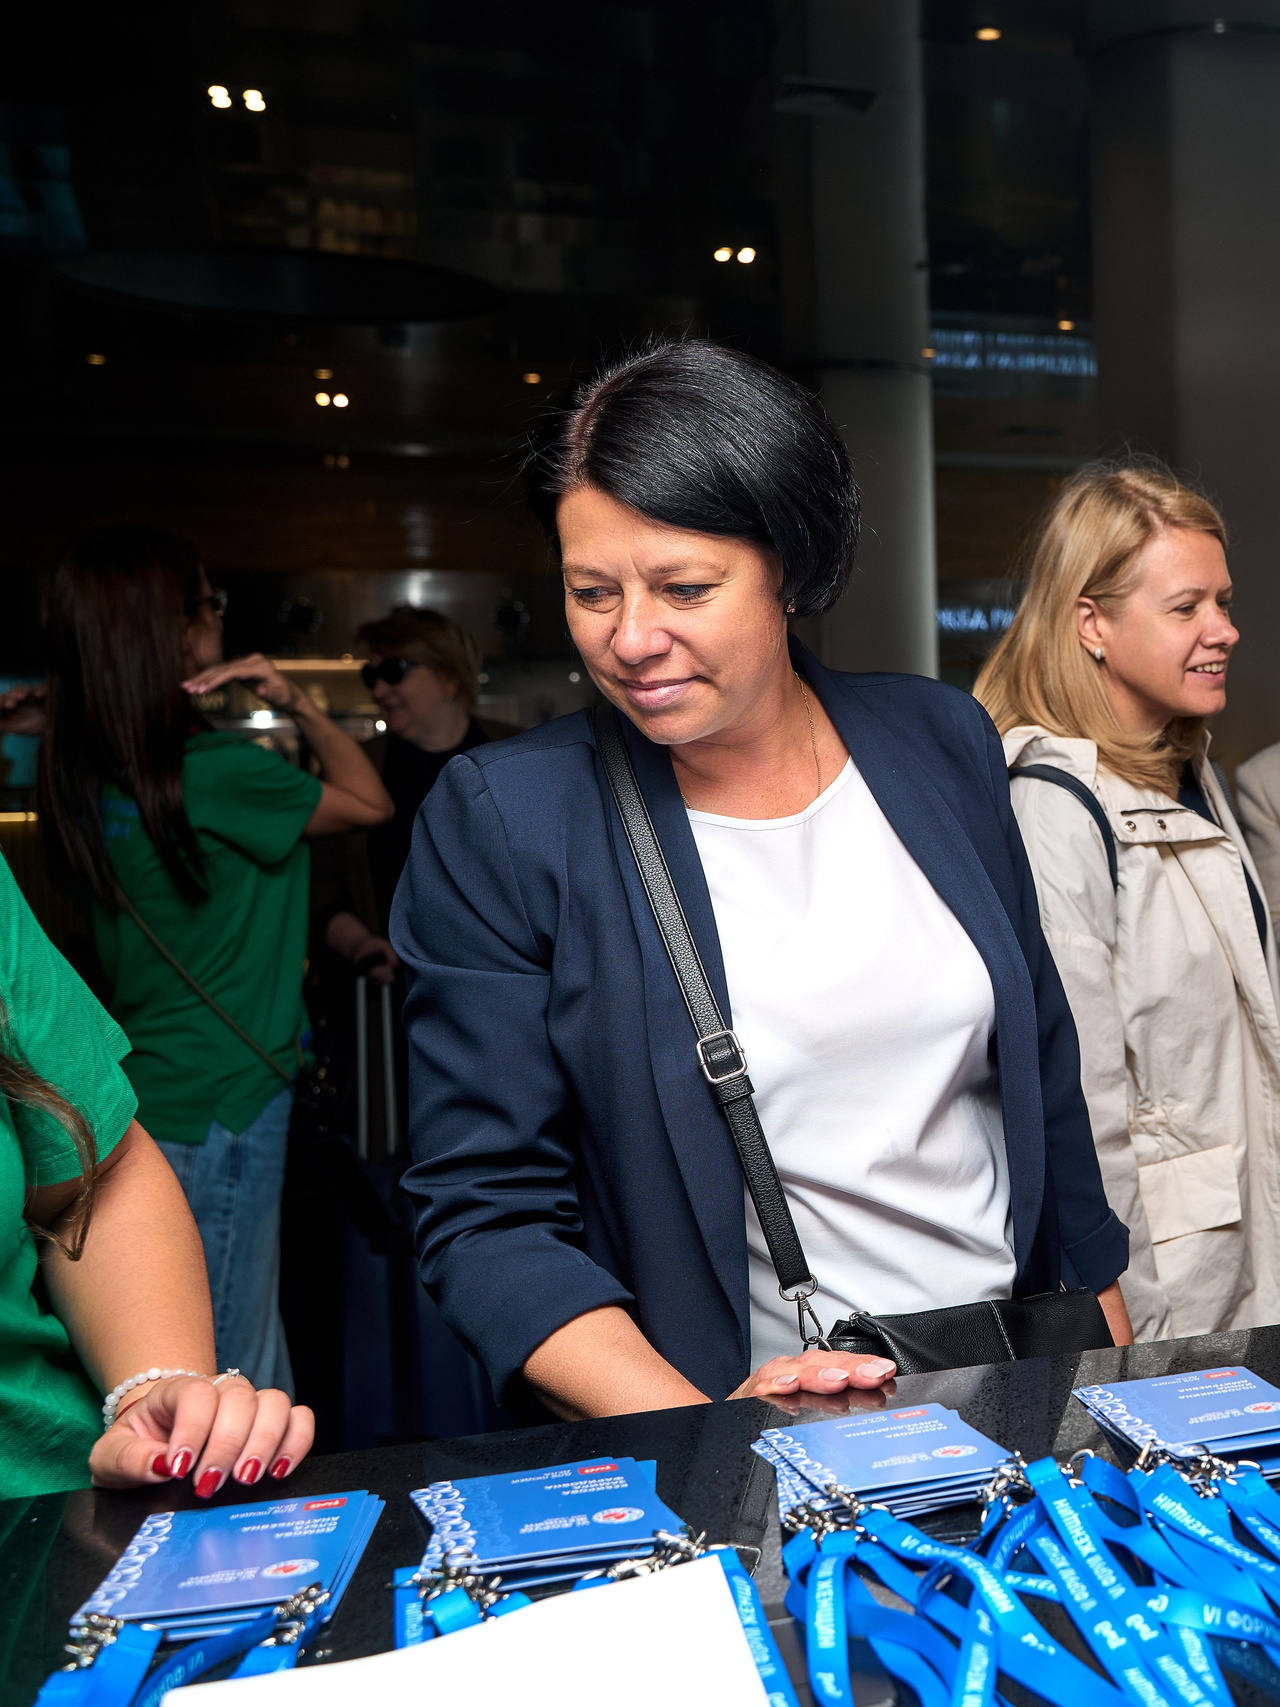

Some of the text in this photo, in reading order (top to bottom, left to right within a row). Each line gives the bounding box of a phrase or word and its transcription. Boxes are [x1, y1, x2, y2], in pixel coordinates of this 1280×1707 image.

[844, 1419, 939, 1438] АЛЕКСАНДРОВНА
[885, 1425, 947, 1438] МАНАКОВА
[544, 1476, 625, 1490] ФАРИДОВНА
[1152, 1492, 1214, 1538] ЖЕНЩИН
[241, 1516, 341, 1533] АНАТОЛЬЕВНА
[274, 1525, 337, 1539] ДИМОВА
[293, 1521, 338, 1532] ОЛЬГА
[1053, 1498, 1126, 1600] VI ФОРУМ ЖЕНЩИН
[958, 1554, 1015, 1614] ЖЕНЩИН
[1203, 1604, 1222, 1626] VI
